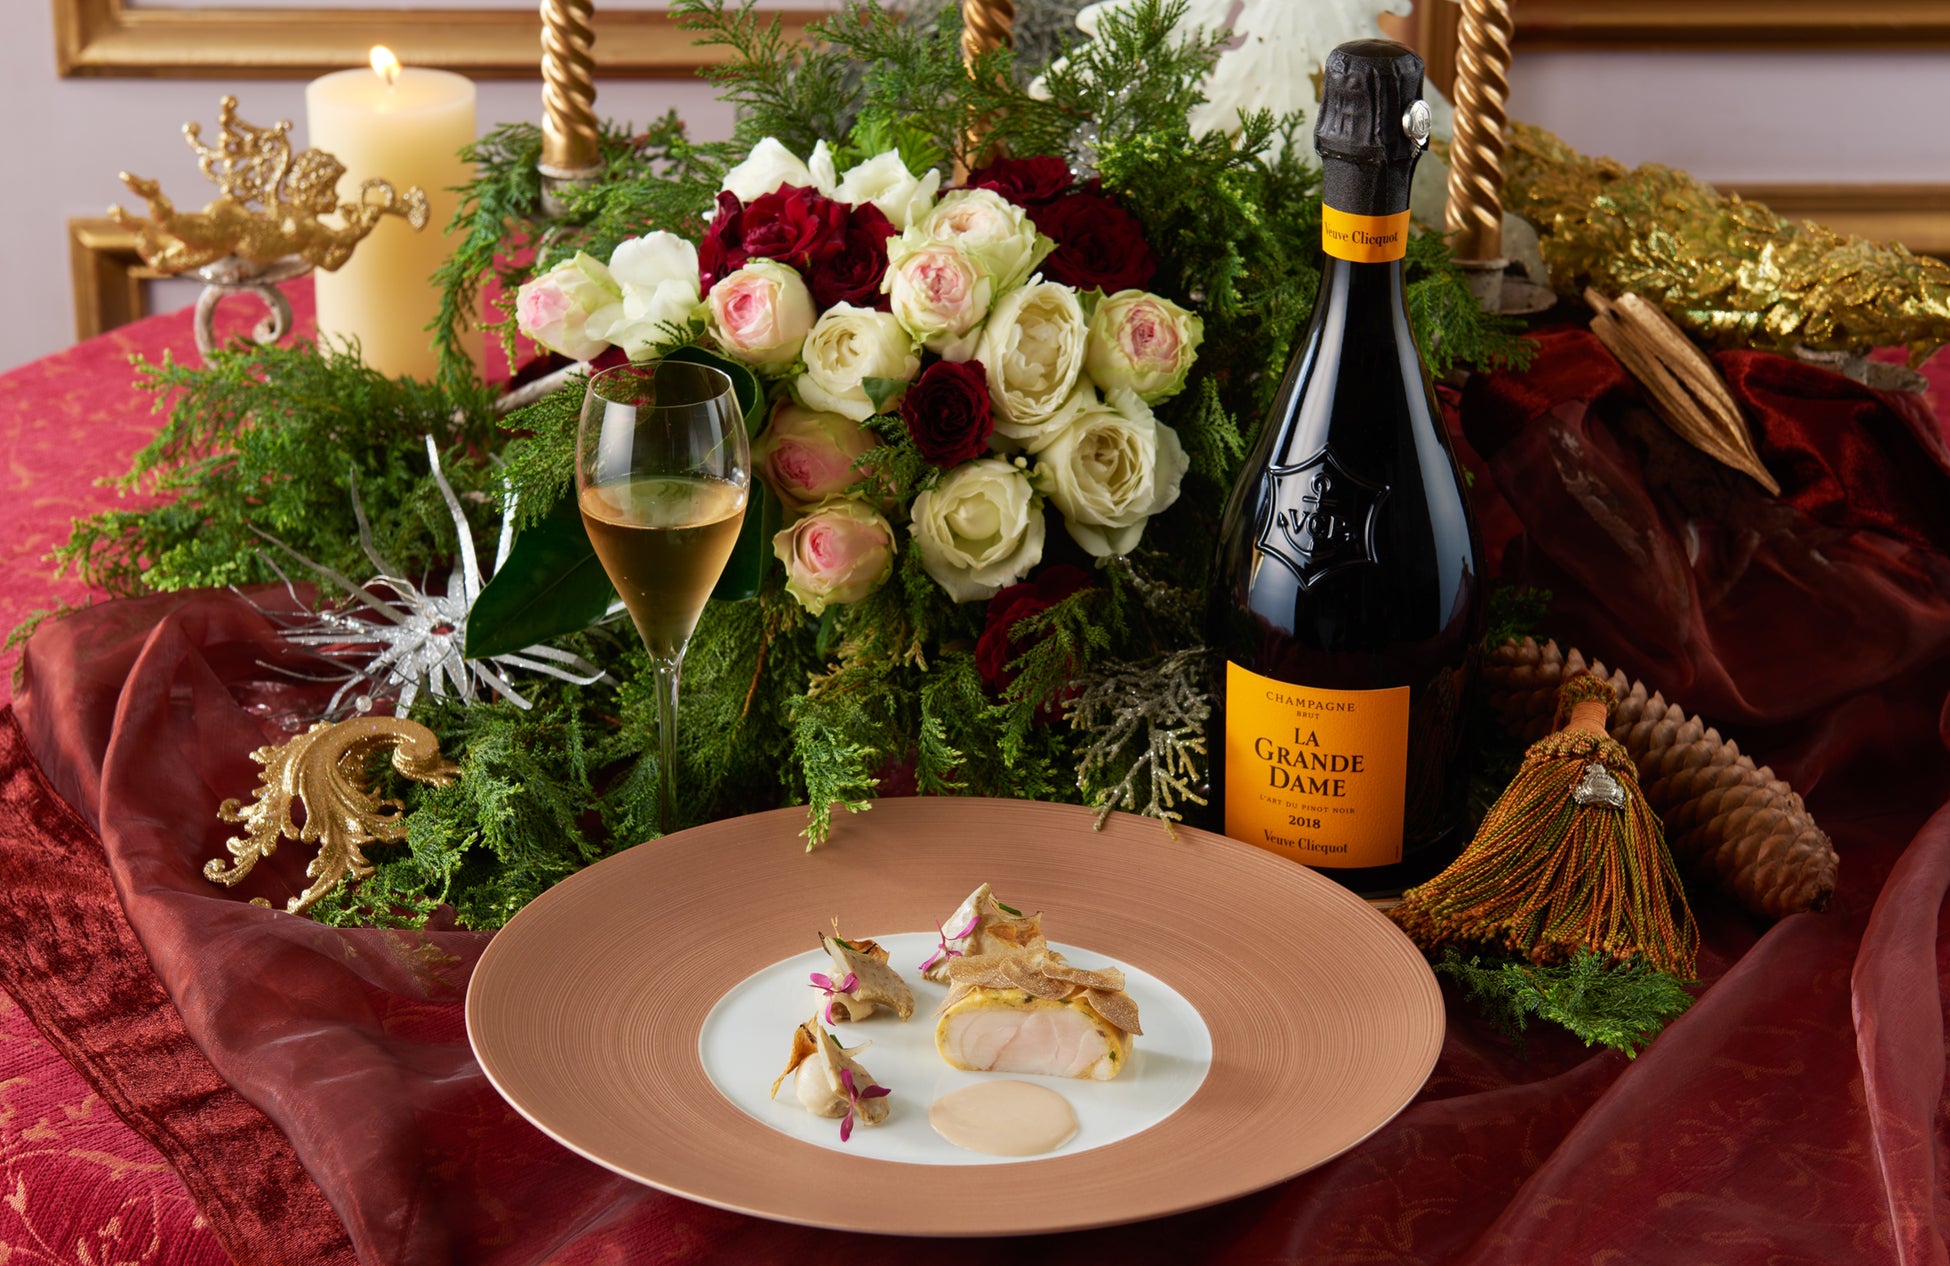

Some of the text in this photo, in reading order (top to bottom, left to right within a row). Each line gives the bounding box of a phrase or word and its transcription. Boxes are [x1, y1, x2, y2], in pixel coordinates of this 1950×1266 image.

[1325, 222, 1398, 247] Veuve Clicquot
[1266, 692, 1355, 712] CHAMPAGNE
[1296, 710, 1320, 720] BRUT
[1295, 728, 1319, 747] LA
[1255, 737, 1364, 772] GRANDE
[1270, 765, 1346, 797] DAME
[1260, 794, 1356, 815] L'ART DU PINOT NOIR
[1289, 815, 1320, 829] 2018
[1264, 829, 1348, 854] Veuve Clicquot
